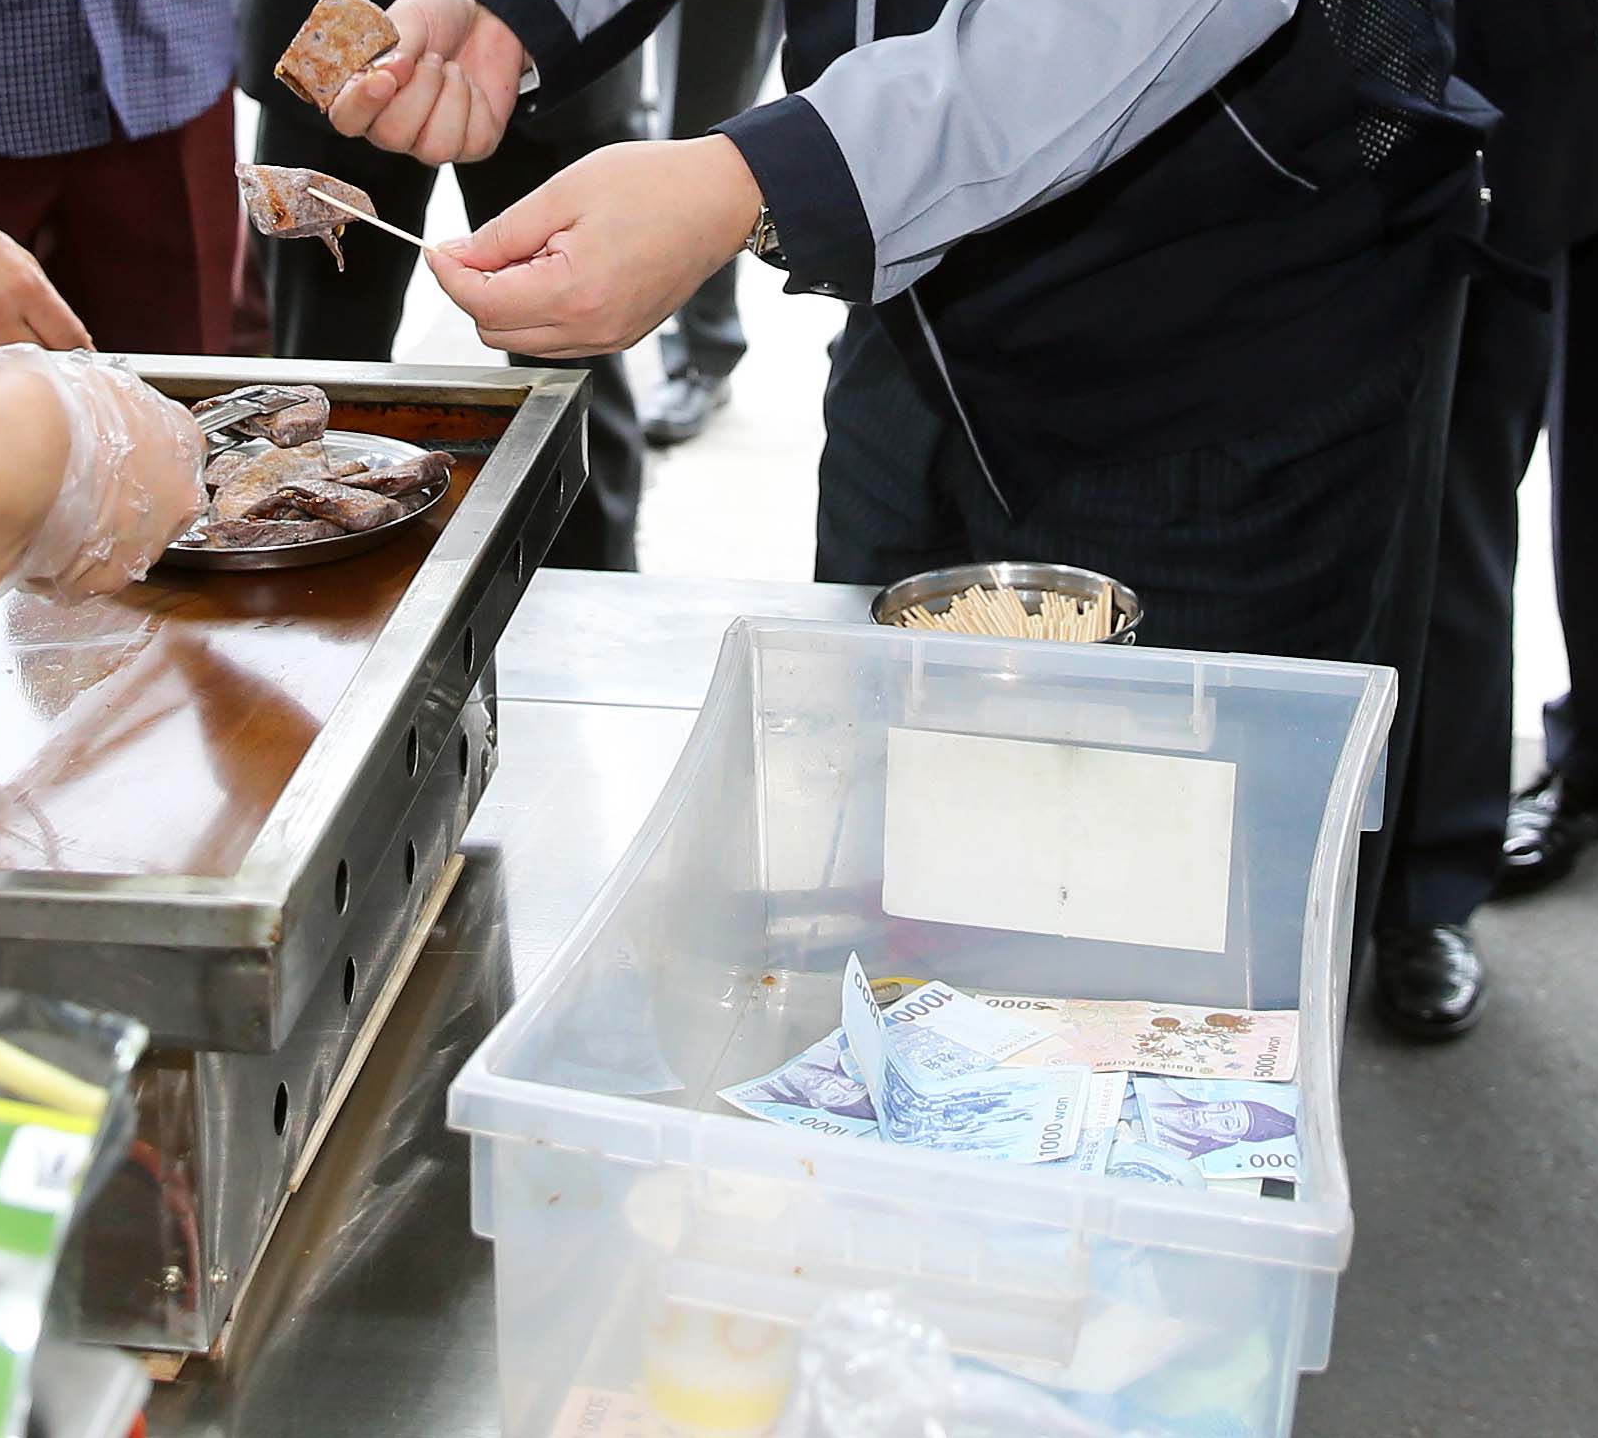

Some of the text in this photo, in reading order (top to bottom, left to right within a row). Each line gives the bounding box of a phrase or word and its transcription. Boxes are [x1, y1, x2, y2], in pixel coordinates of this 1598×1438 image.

[893, 988, 954, 1023] 1000
[1253, 1053, 1278, 1078] 5000
[1037, 1096, 1069, 1158] 1000 won
